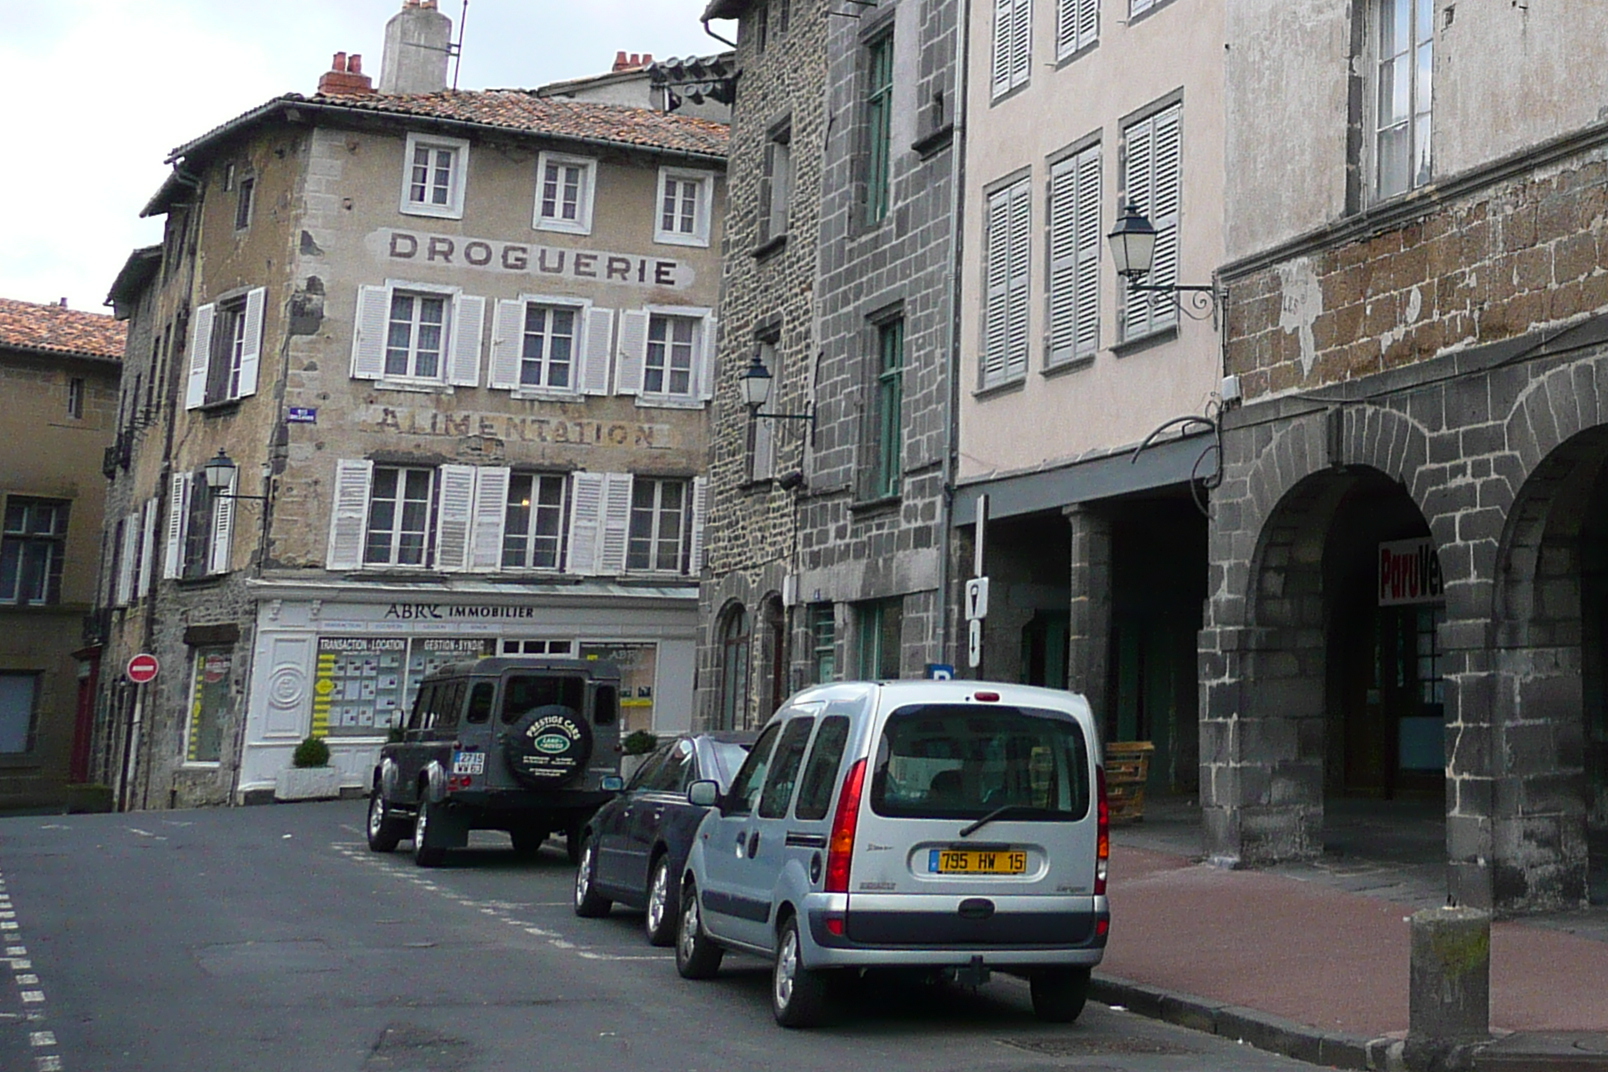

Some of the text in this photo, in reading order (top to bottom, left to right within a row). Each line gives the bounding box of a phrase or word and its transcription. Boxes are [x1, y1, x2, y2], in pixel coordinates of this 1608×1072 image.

[388, 232, 678, 286] DROGUERIE
[375, 408, 655, 447] ALIMENTATION
[1381, 543, 1445, 600] ParuVe
[449, 606, 535, 618] IMMOBILIER
[320, 639, 405, 650] TRANSACTION LOCATION
[424, 639, 485, 651] GESTION SYNDIC
[526, 715, 582, 740] PRESTIGE CARS
[941, 853, 1023, 870] 795 HW 15
